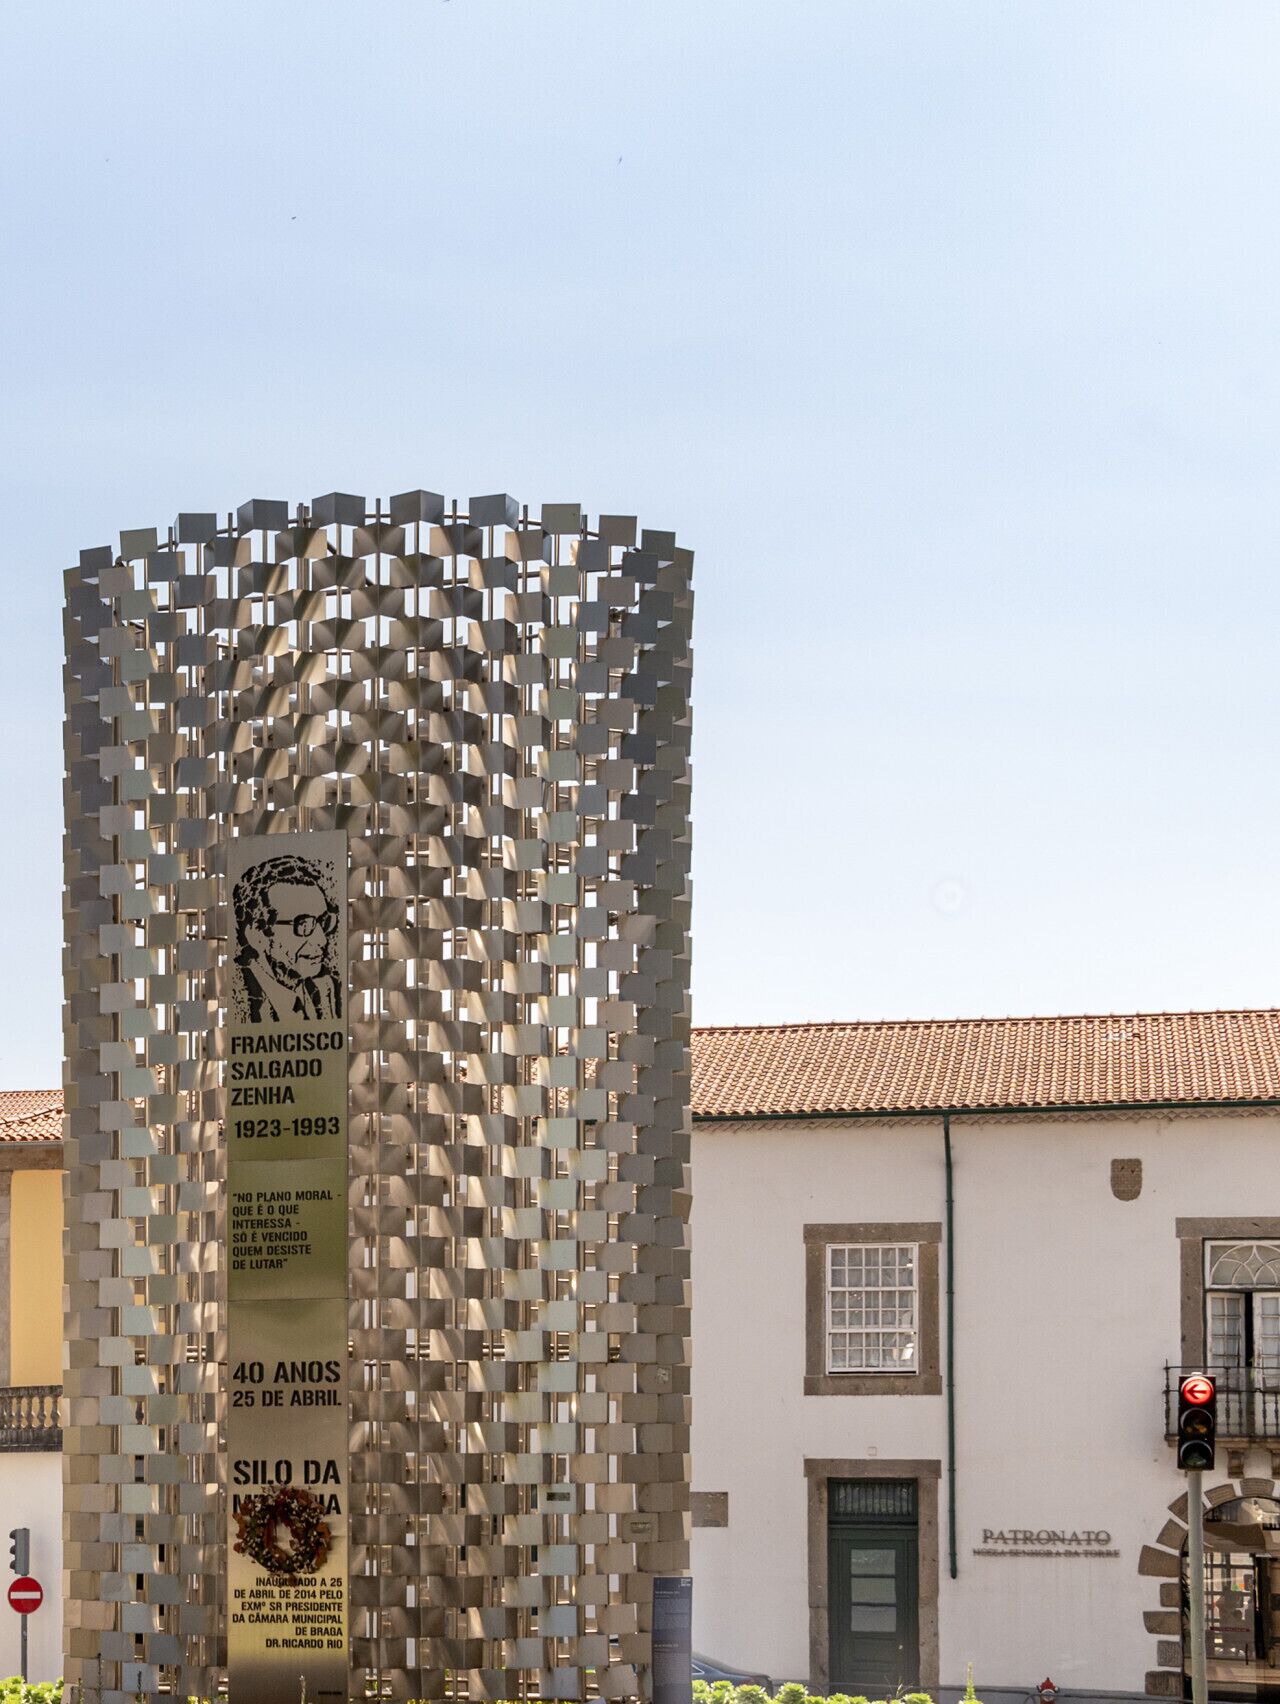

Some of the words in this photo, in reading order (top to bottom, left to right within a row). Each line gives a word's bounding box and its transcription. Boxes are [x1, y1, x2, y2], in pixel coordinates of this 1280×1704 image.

[231, 1031, 343, 1054] FRANCISCO
[231, 1058, 322, 1080] SALGADO
[231, 1086, 295, 1106] ZENHA
[235, 1116, 340, 1138] 1923-1993
[256, 1191, 291, 1202] PLANO
[295, 1190, 333, 1201] MORAL
[232, 1206, 253, 1217] QUE
[257, 1204, 263, 1215] É
[267, 1205, 274, 1215] O
[278, 1204, 299, 1216] QUE
[232, 1218, 292, 1229] INTERESSA
[232, 1231, 247, 1243] SÓ
[251, 1231, 257, 1242] É
[261, 1231, 307, 1242] VENCIDO
[232, 1246, 262, 1257] QUEM
[267, 1244, 312, 1256] DESISTE
[232, 1260, 246, 1270] DE
[232, 1361, 265, 1383] 40
[273, 1360, 341, 1383] ANOS
[232, 1390, 255, 1407] 25
[262, 1390, 284, 1407] DE
[290, 1389, 342, 1406] ABRIL
[233, 1459, 293, 1485] SILO
[304, 1459, 341, 1485] DA
[982, 1528, 1112, 1546] PATRONATO
[256, 1577, 317, 1587] INAUGADO
[320, 1577, 327, 1587] A
[330, 1577, 343, 1587] 25
[234, 1589, 246, 1599] DE
[249, 1589, 276, 1599] ABRIL
[279, 1589, 291, 1599] DE
[294, 1589, 317, 1599] 2014
[320, 1590, 343, 1600] PELO
[269, 1602, 283, 1611] SR
[285, 1602, 343, 1612] PRESIDENTE
[232, 1613, 245, 1623] DA
[248, 1612, 289, 1623] CÂMARA
[292, 1614, 343, 1624] MUNICIPAL
[295, 1626, 307, 1636] DE
[310, 1626, 343, 1637] BRAGA
[327, 1639, 343, 1649] RIO
